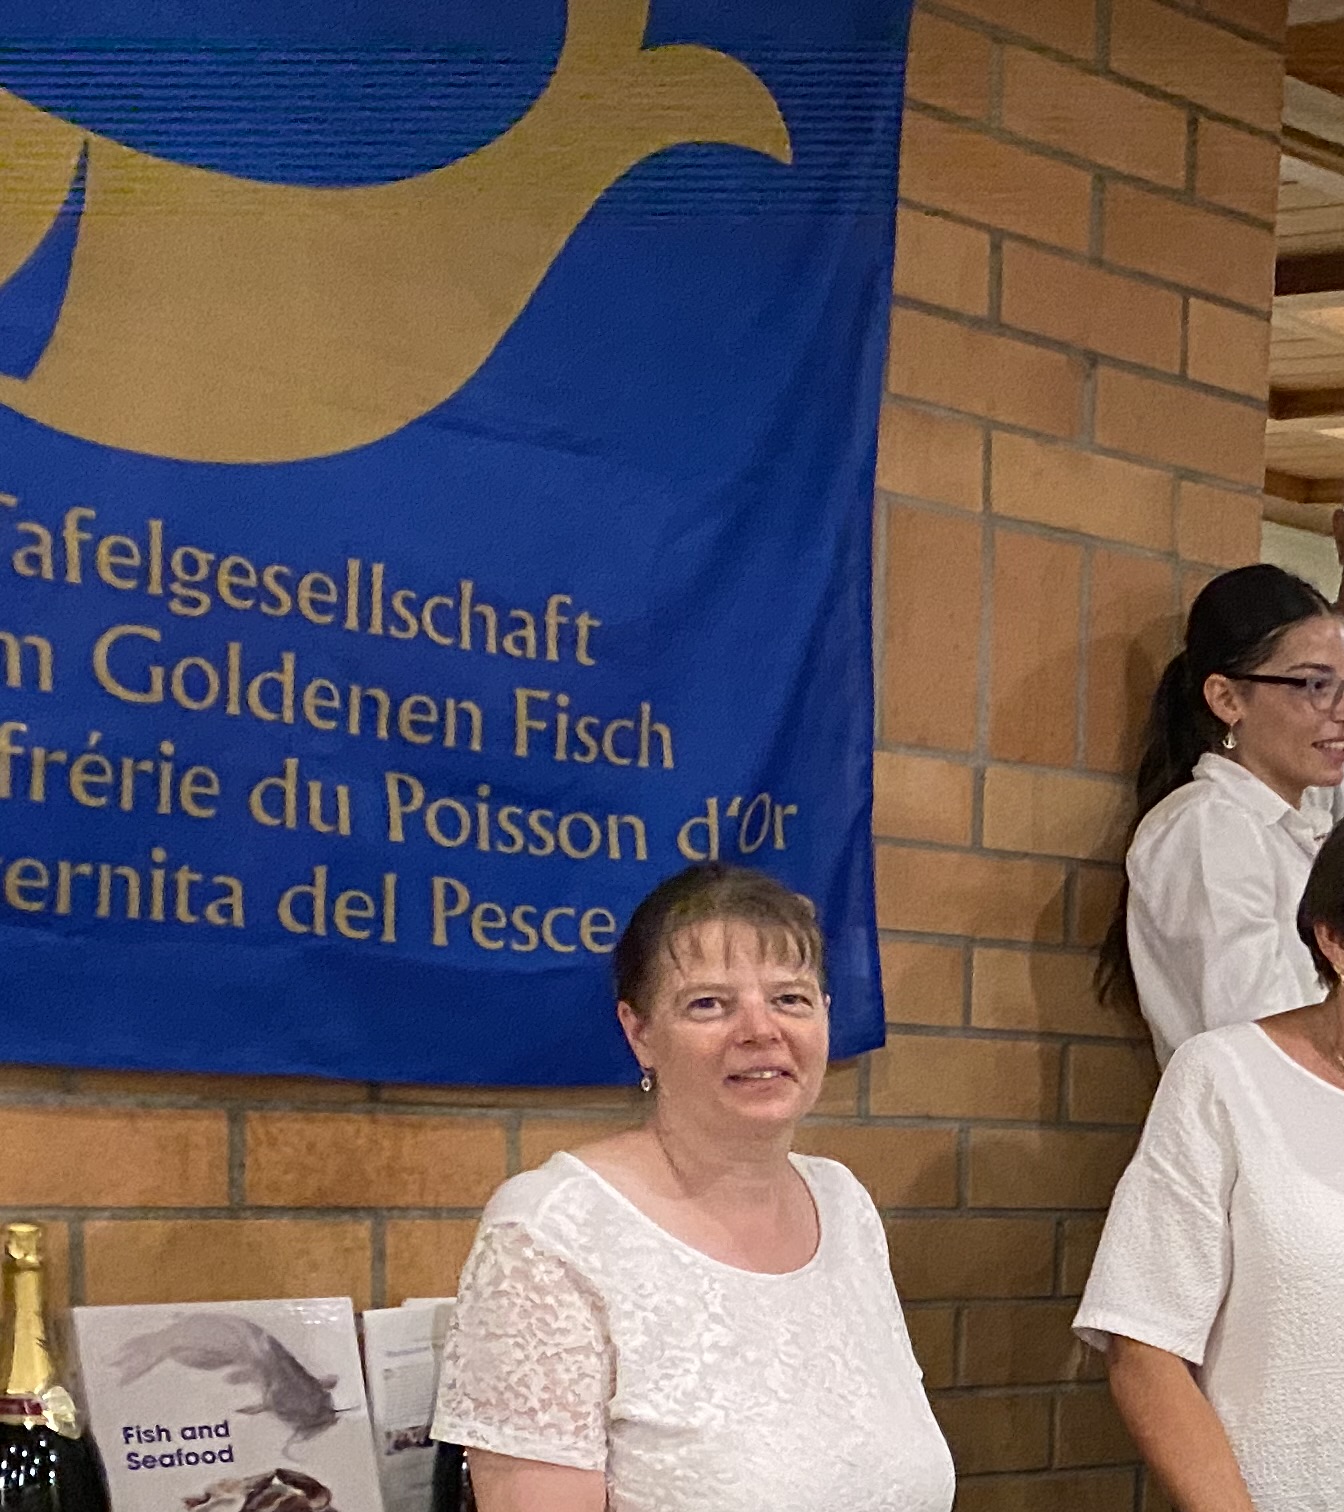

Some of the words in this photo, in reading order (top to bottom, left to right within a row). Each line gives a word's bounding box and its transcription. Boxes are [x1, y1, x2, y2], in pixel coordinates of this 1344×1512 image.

[0, 492, 602, 665] afelgesellschaft
[93, 624, 482, 751] Goldenen
[514, 687, 674, 769] Fisch
[0, 721, 220, 818] frérie
[249, 757, 351, 836] du
[385, 771, 648, 861] Poisson
[277, 865, 397, 943] del
[431, 876, 616, 953] Pesce
[122, 1424, 171, 1444] Fish
[180, 1420, 230, 1440] and
[126, 1444, 234, 1470] Seafood
